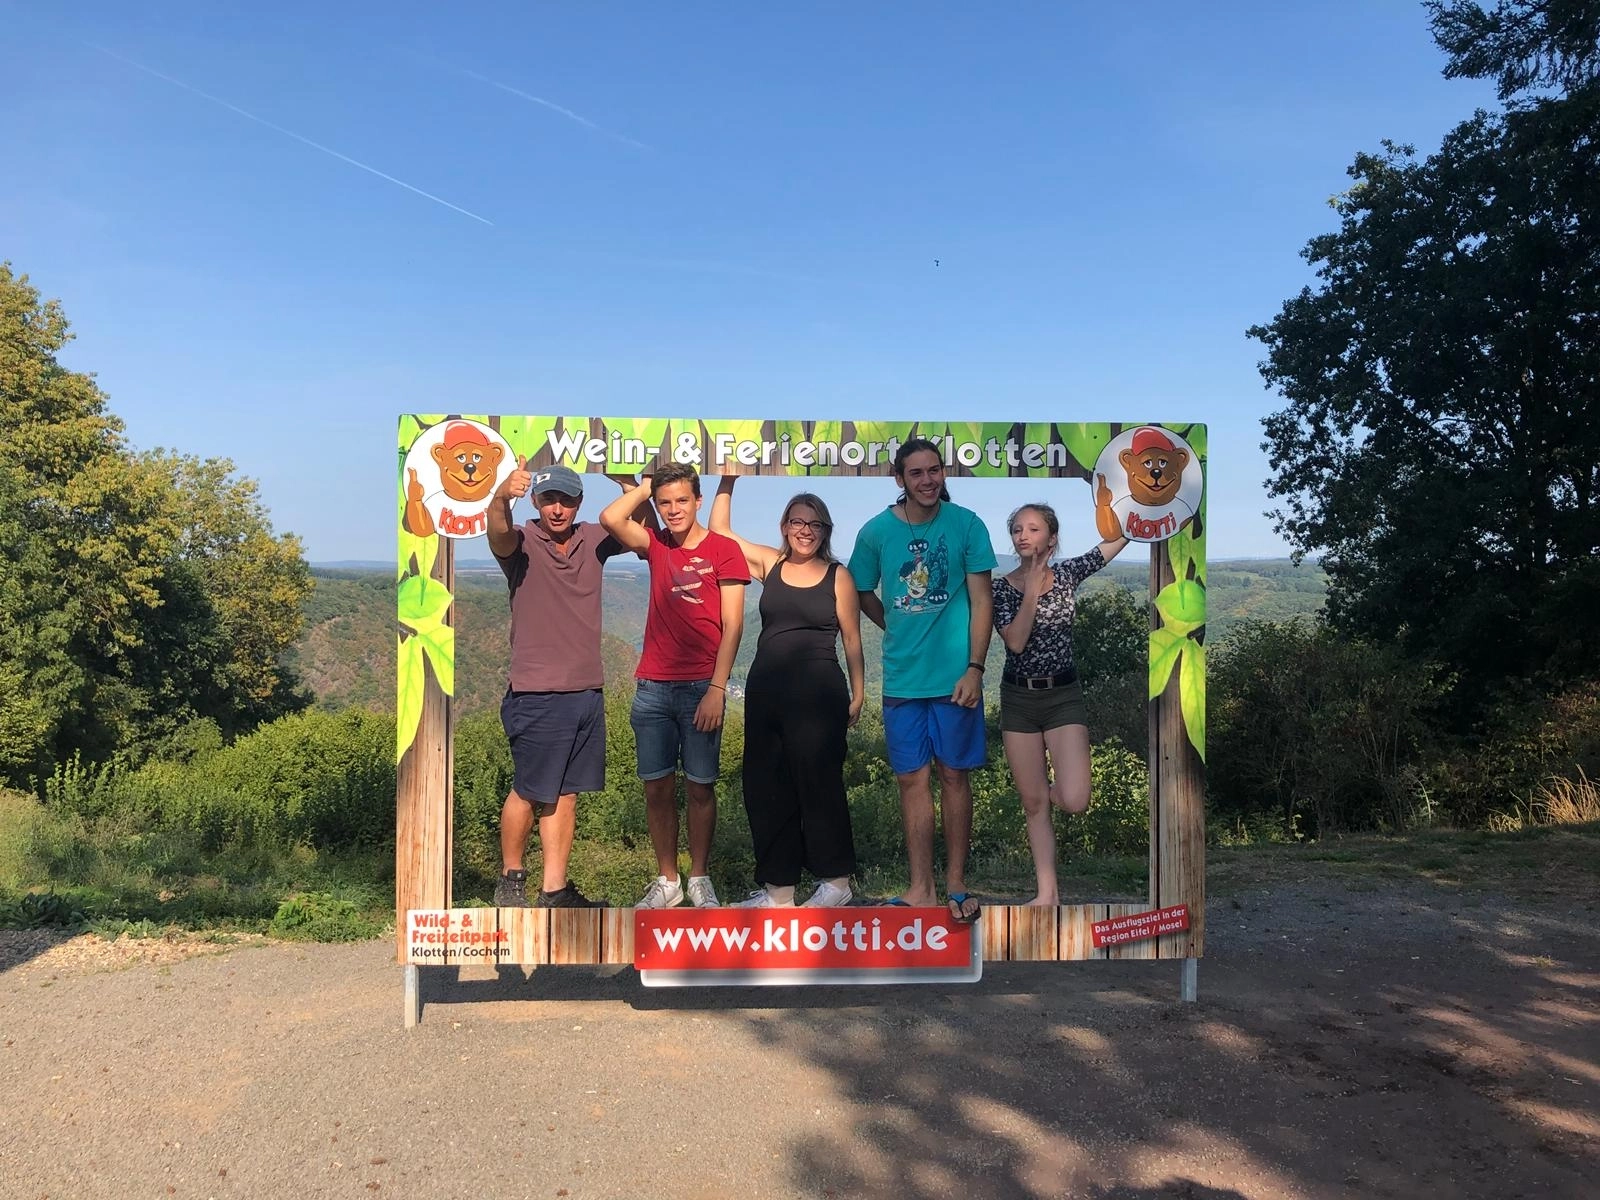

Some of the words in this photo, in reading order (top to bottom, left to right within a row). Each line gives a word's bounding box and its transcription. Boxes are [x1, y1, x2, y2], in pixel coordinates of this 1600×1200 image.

[546, 429, 661, 465] Wein-
[673, 431, 703, 466] &
[714, 432, 901, 468] Ferienort
[916, 434, 1067, 469] lotten
[413, 913, 456, 928] Wild-
[461, 913, 473, 928] &
[1094, 925, 1110, 934] Das
[1111, 913, 1161, 931] Ausflugsziel
[1162, 911, 1170, 920] in
[1171, 909, 1185, 918] der
[1100, 931, 1130, 944] Region
[1130, 927, 1150, 938] Eifel
[1151, 925, 1156, 935] /
[1158, 919, 1183, 932] Mosel
[412, 928, 509, 946] Freizeitpark
[652, 917, 949, 953] www.klotti.de
[411, 946, 510, 957] Klotten/Cochem
